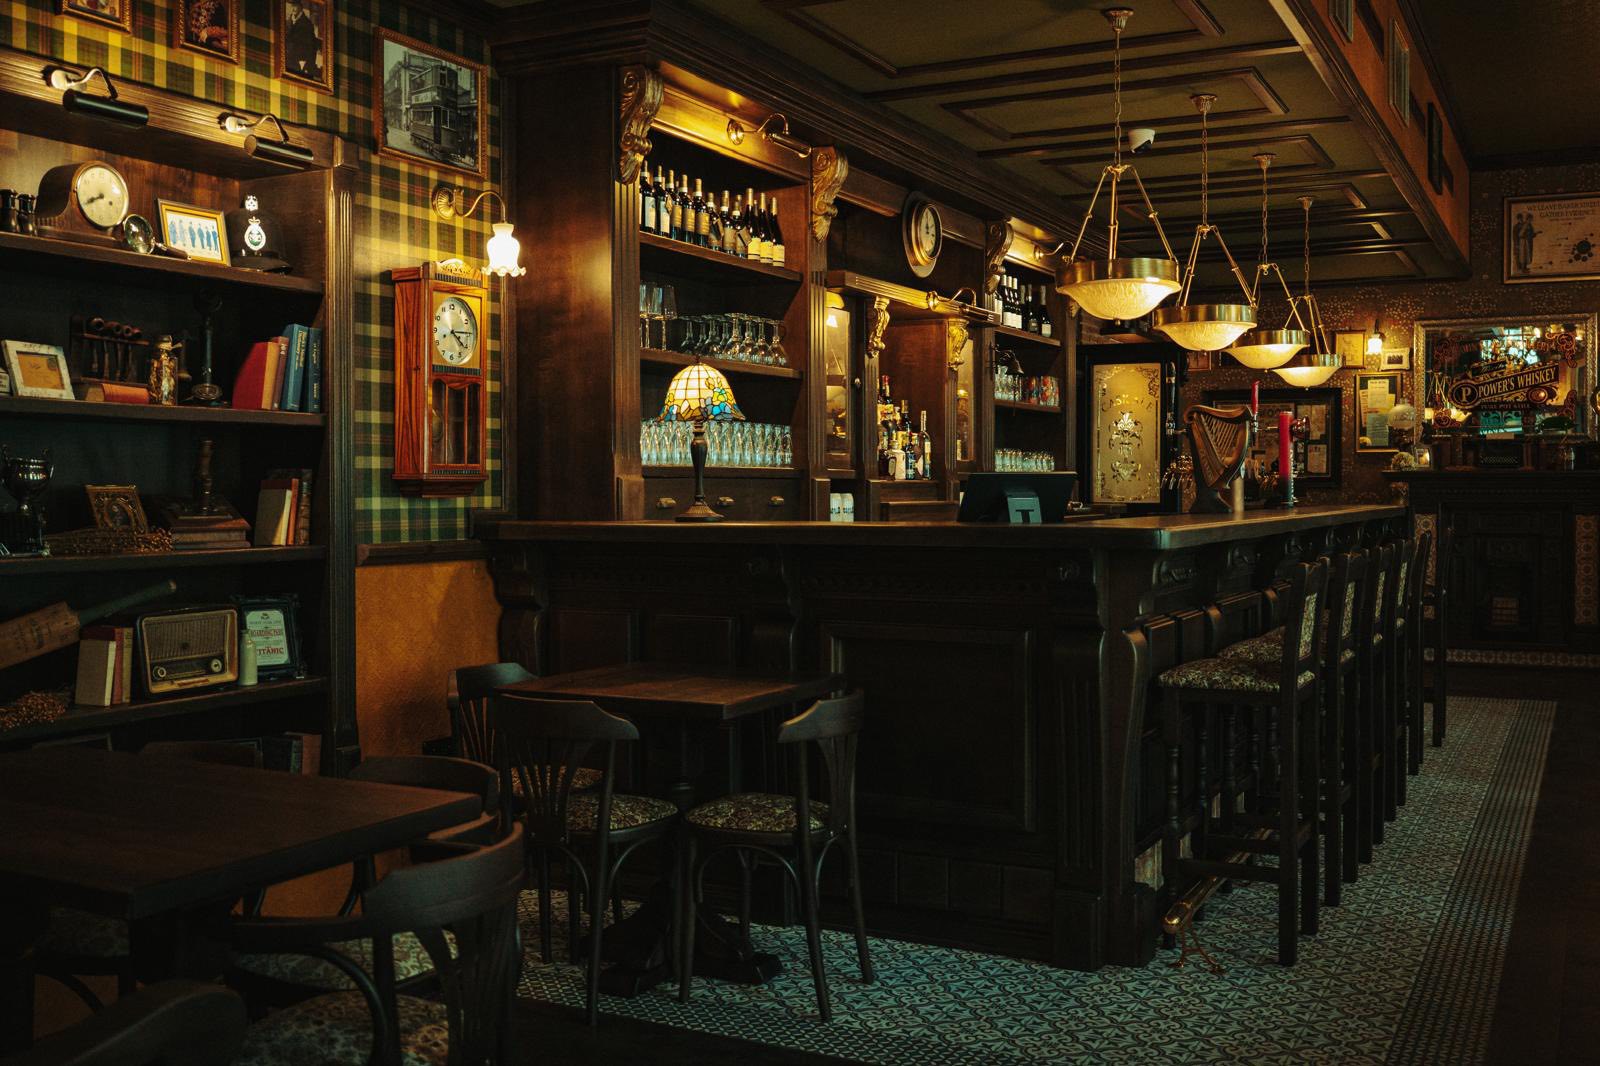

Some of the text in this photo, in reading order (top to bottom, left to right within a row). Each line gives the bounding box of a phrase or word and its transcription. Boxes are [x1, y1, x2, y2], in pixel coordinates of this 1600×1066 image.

[1460, 386, 1471, 403] P
[1478, 376, 1515, 398] POWER'S
[1517, 367, 1557, 388] WHISKEY
